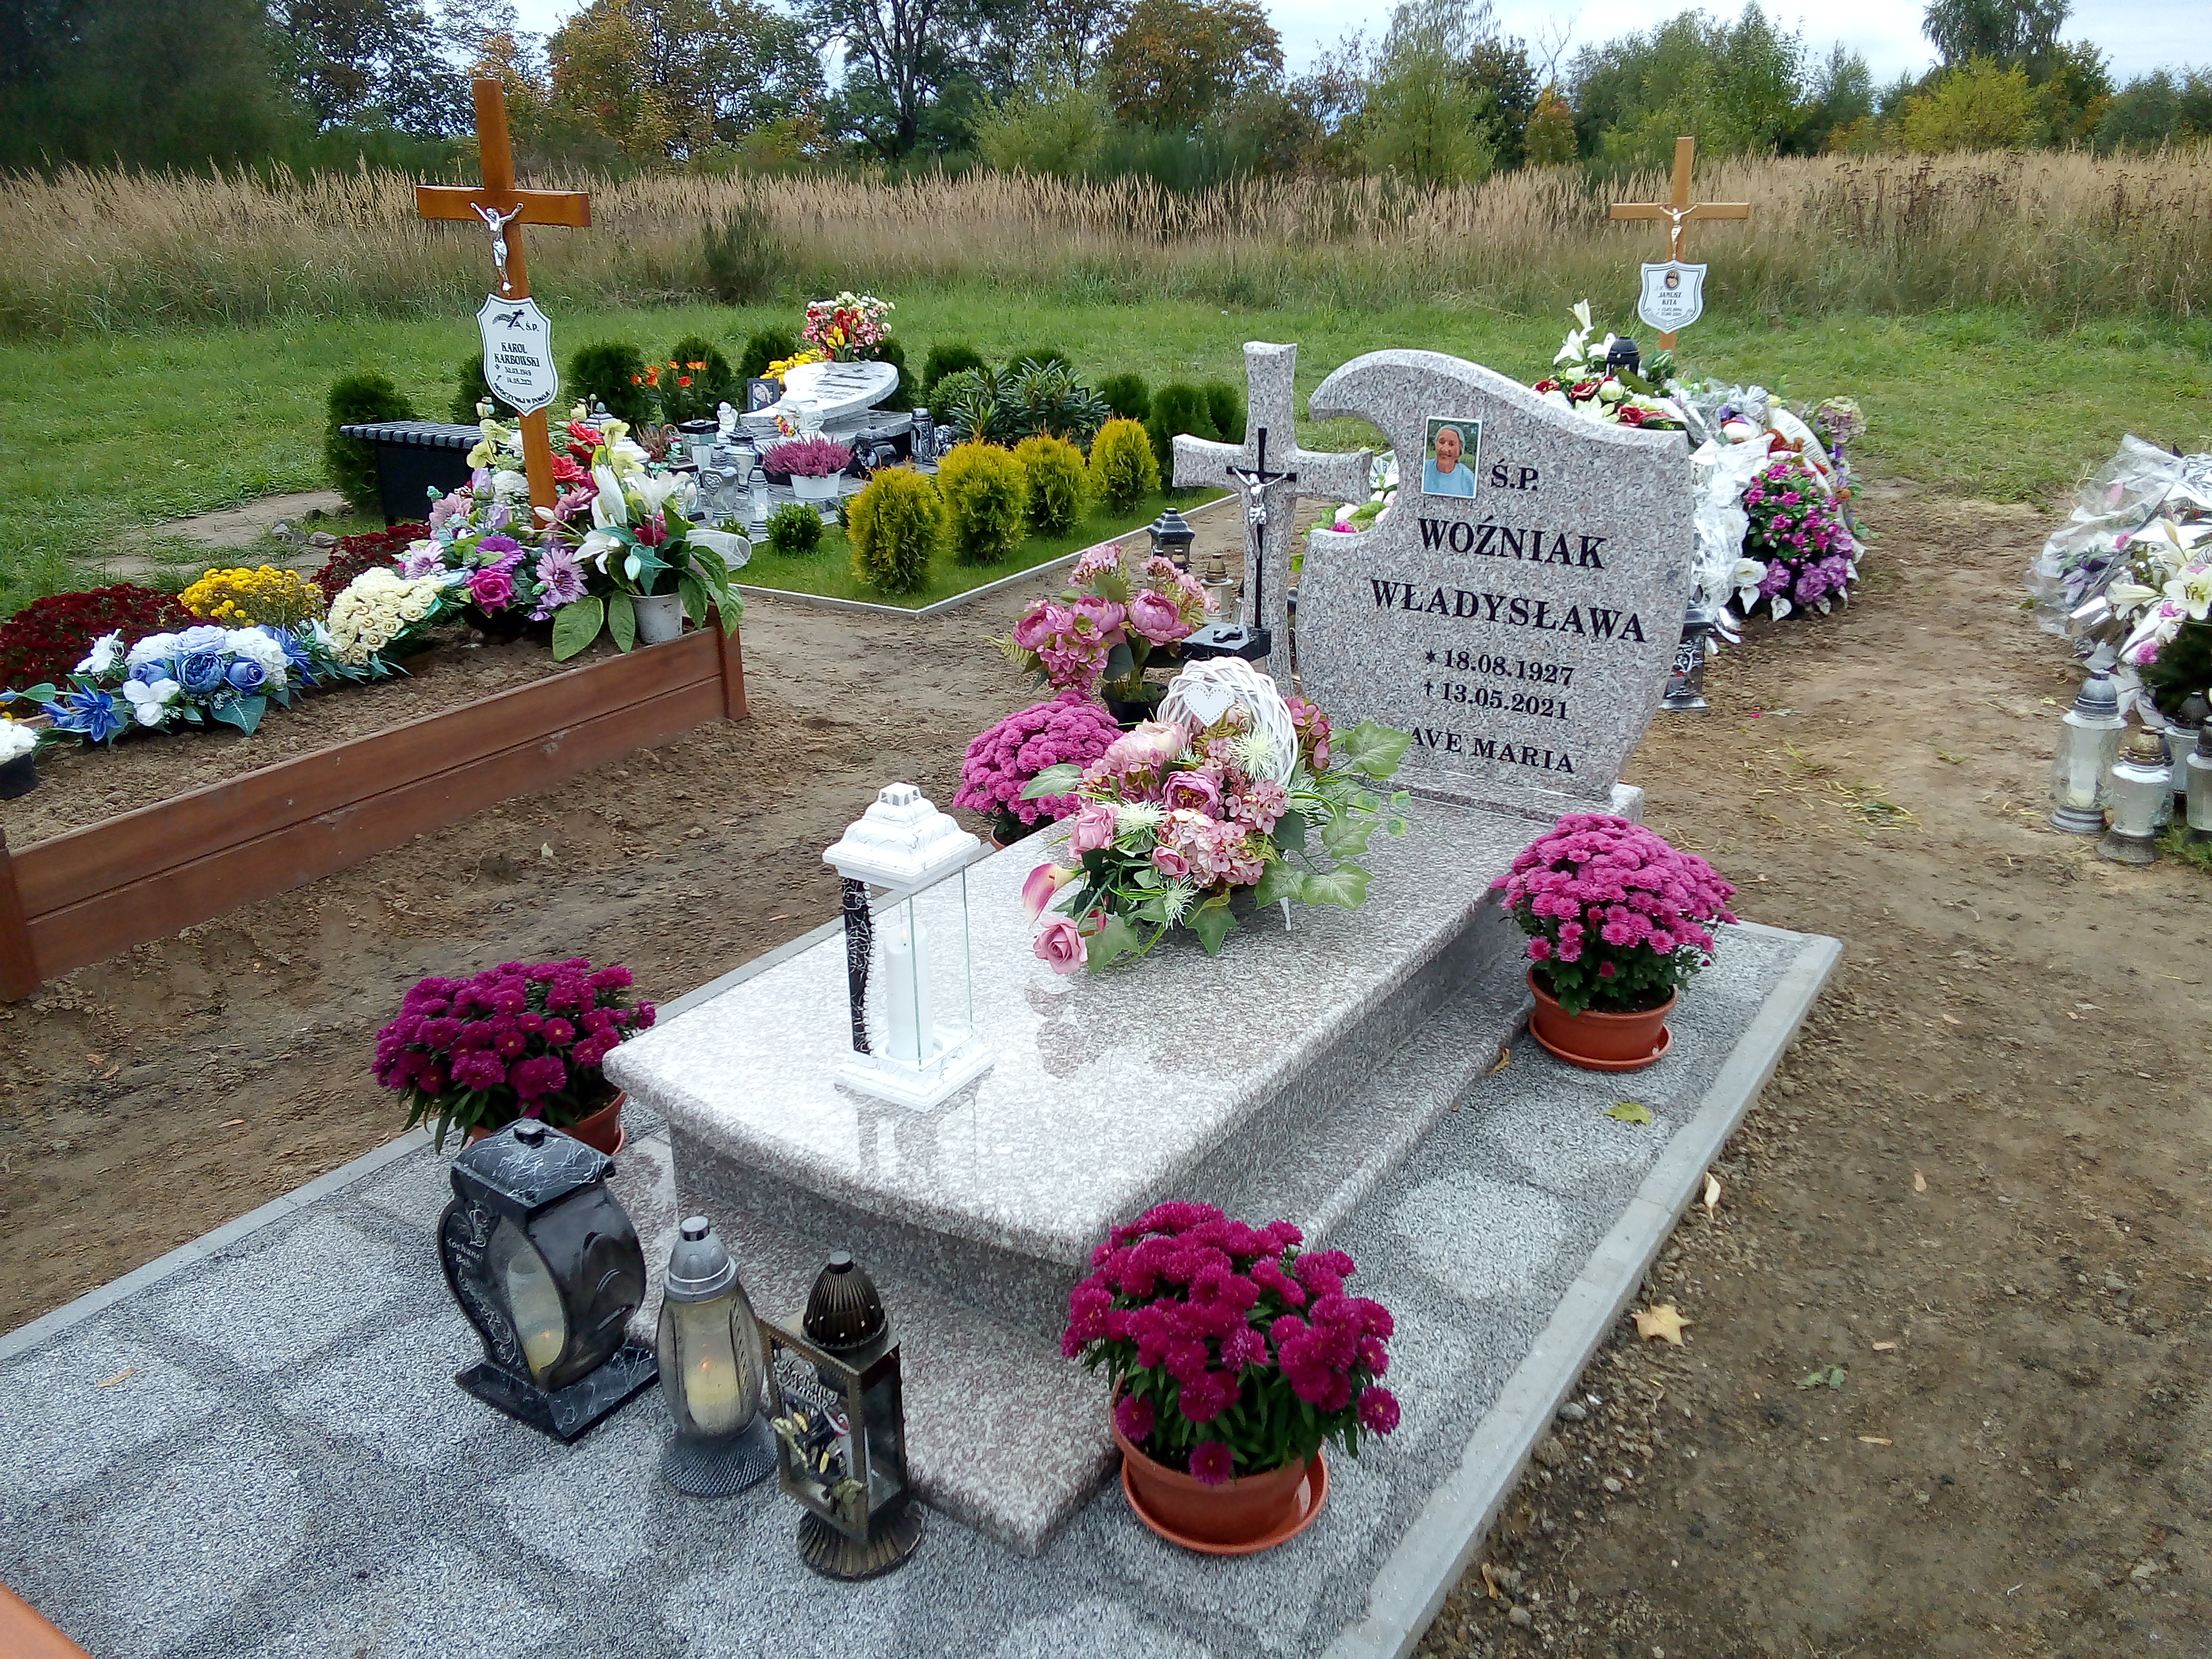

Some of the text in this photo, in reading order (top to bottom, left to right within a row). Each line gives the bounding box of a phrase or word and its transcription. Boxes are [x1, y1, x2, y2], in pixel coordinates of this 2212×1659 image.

[493, 352, 540, 367] KARBOWSKI
[501, 342, 527, 354] KAROL
[1491, 459, 1539, 491] Ś.P.
[1418, 514, 1607, 570] WOŹNIAK
[1371, 579, 1646, 642] WŁADYSŁAWA
[1444, 649, 1575, 687] 18.08.1927
[1441, 680, 1569, 720] 13.05.2021
[1412, 726, 1574, 774] AVE MARIA
